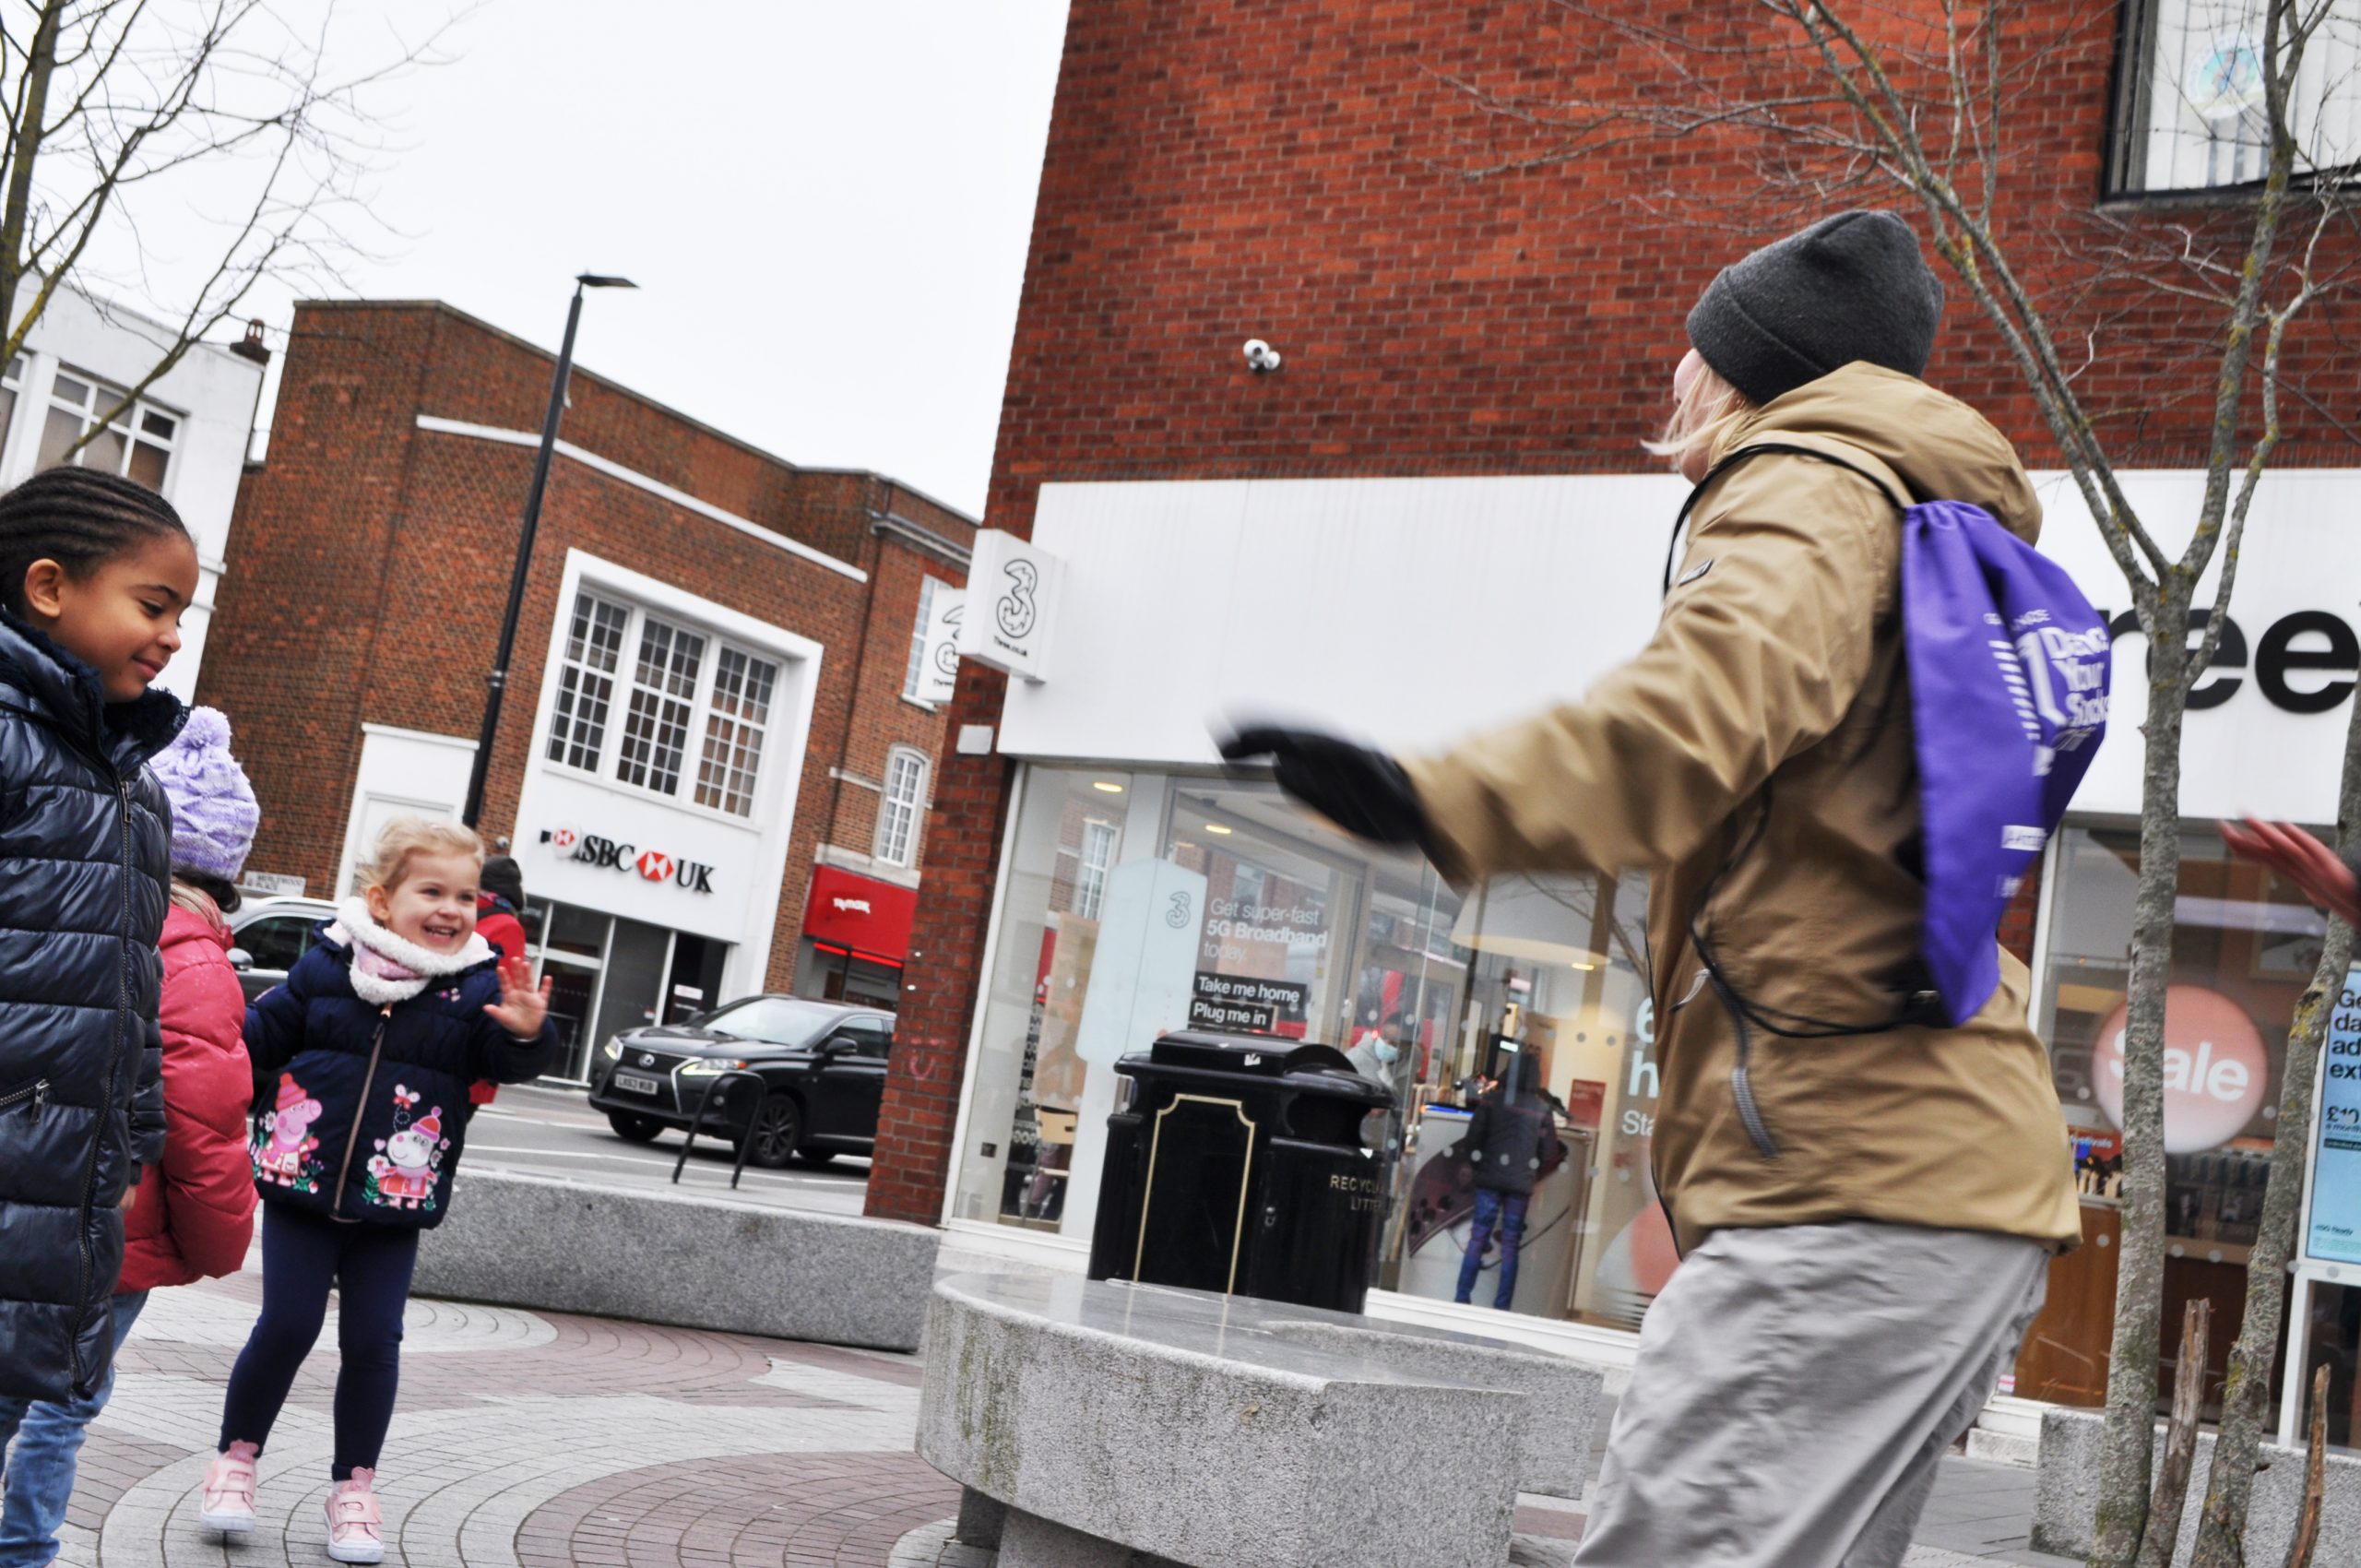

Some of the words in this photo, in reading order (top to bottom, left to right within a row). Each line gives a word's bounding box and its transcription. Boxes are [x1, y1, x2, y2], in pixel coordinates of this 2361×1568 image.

[675, 858, 715, 894] UK
[1210, 897, 1240, 918] Get
[1241, 904, 1321, 926] super-fast
[1206, 919, 1232, 938] 5G
[1234, 921, 1329, 949] Broadband
[1199, 976, 1231, 995] Take
[1232, 984, 1256, 998] me
[1258, 983, 1300, 1004] home
[1193, 1002, 1226, 1024] Plug
[1227, 1009, 1252, 1024] me
[1252, 1010, 1267, 1026] in
